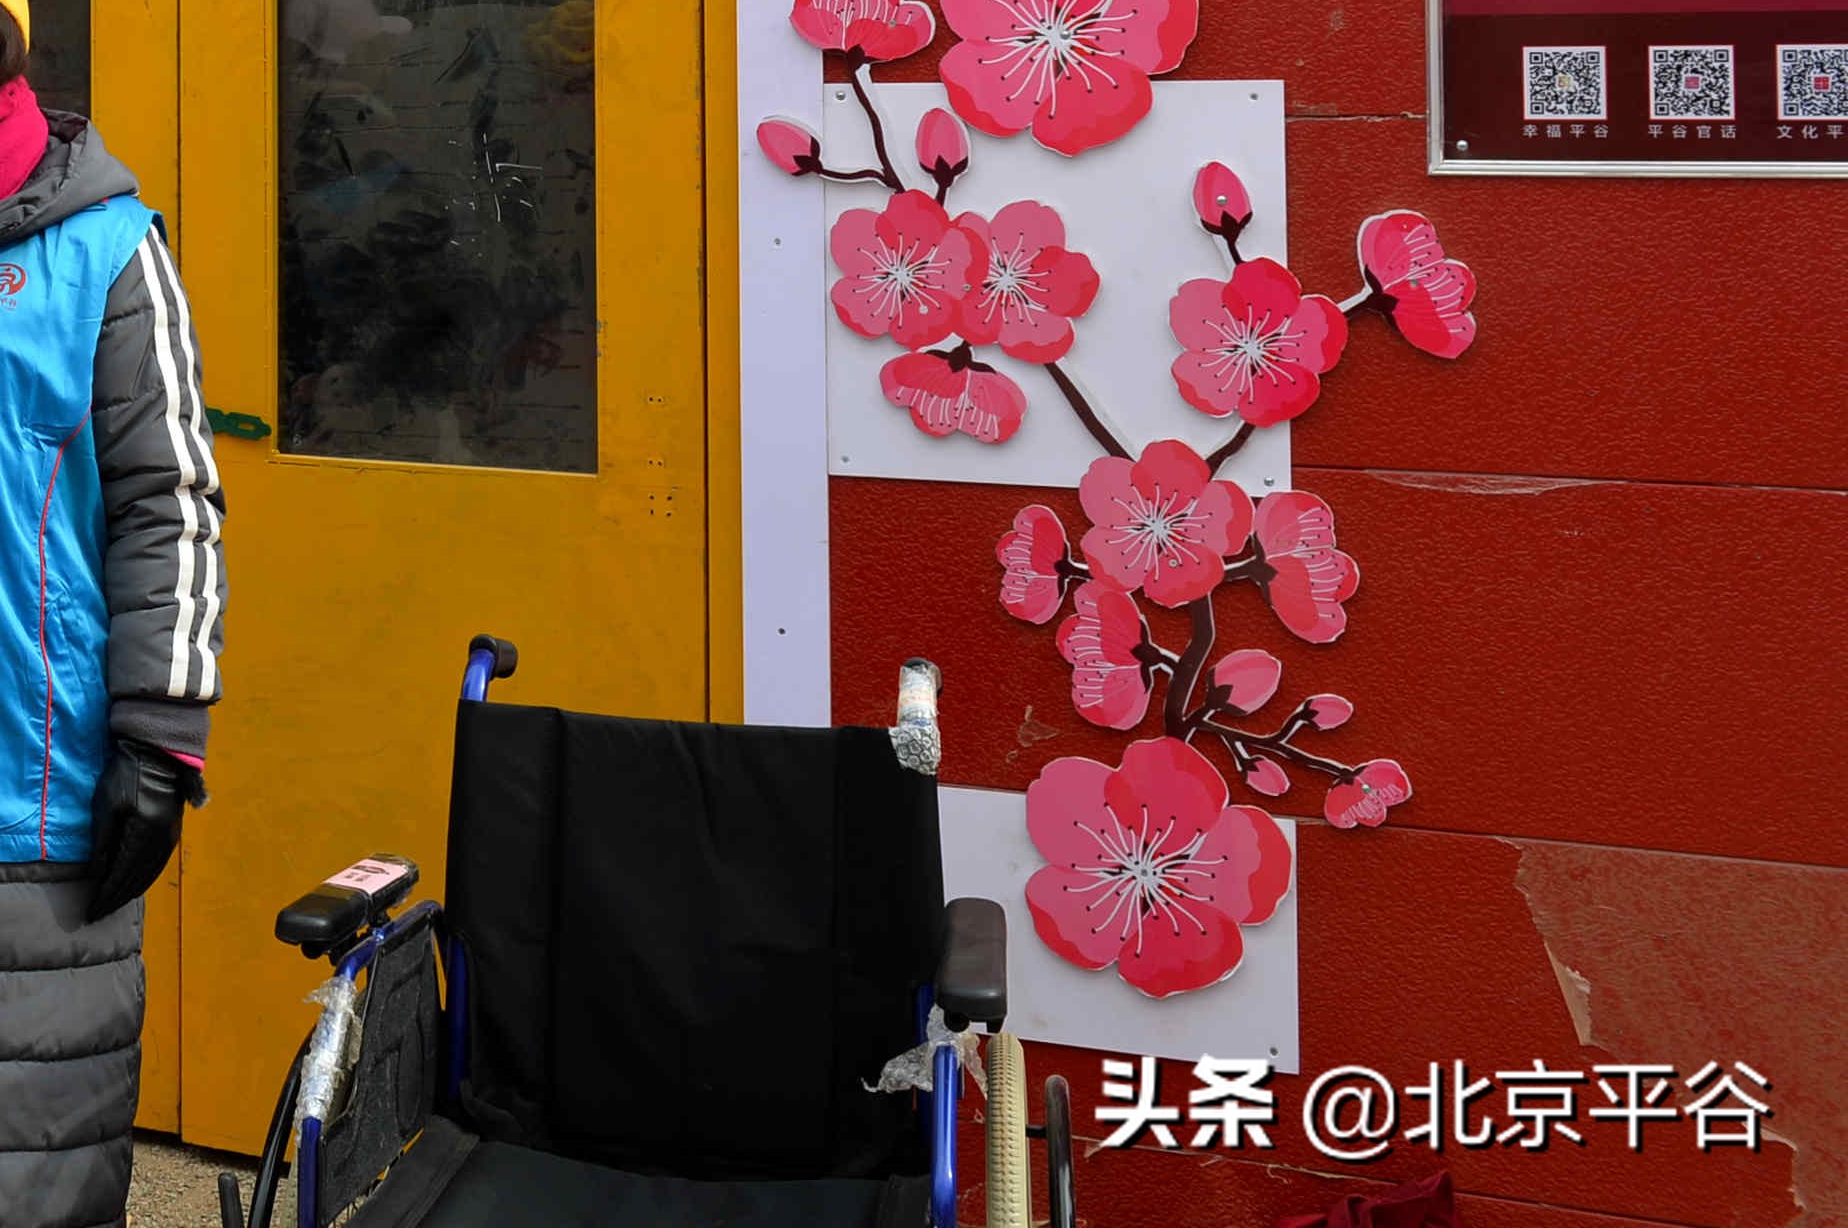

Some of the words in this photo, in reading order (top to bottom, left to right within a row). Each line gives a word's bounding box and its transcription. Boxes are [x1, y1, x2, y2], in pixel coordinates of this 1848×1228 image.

[1522, 123, 1609, 139] 幸福平谷
[1648, 123, 1737, 139] 平谷官话
